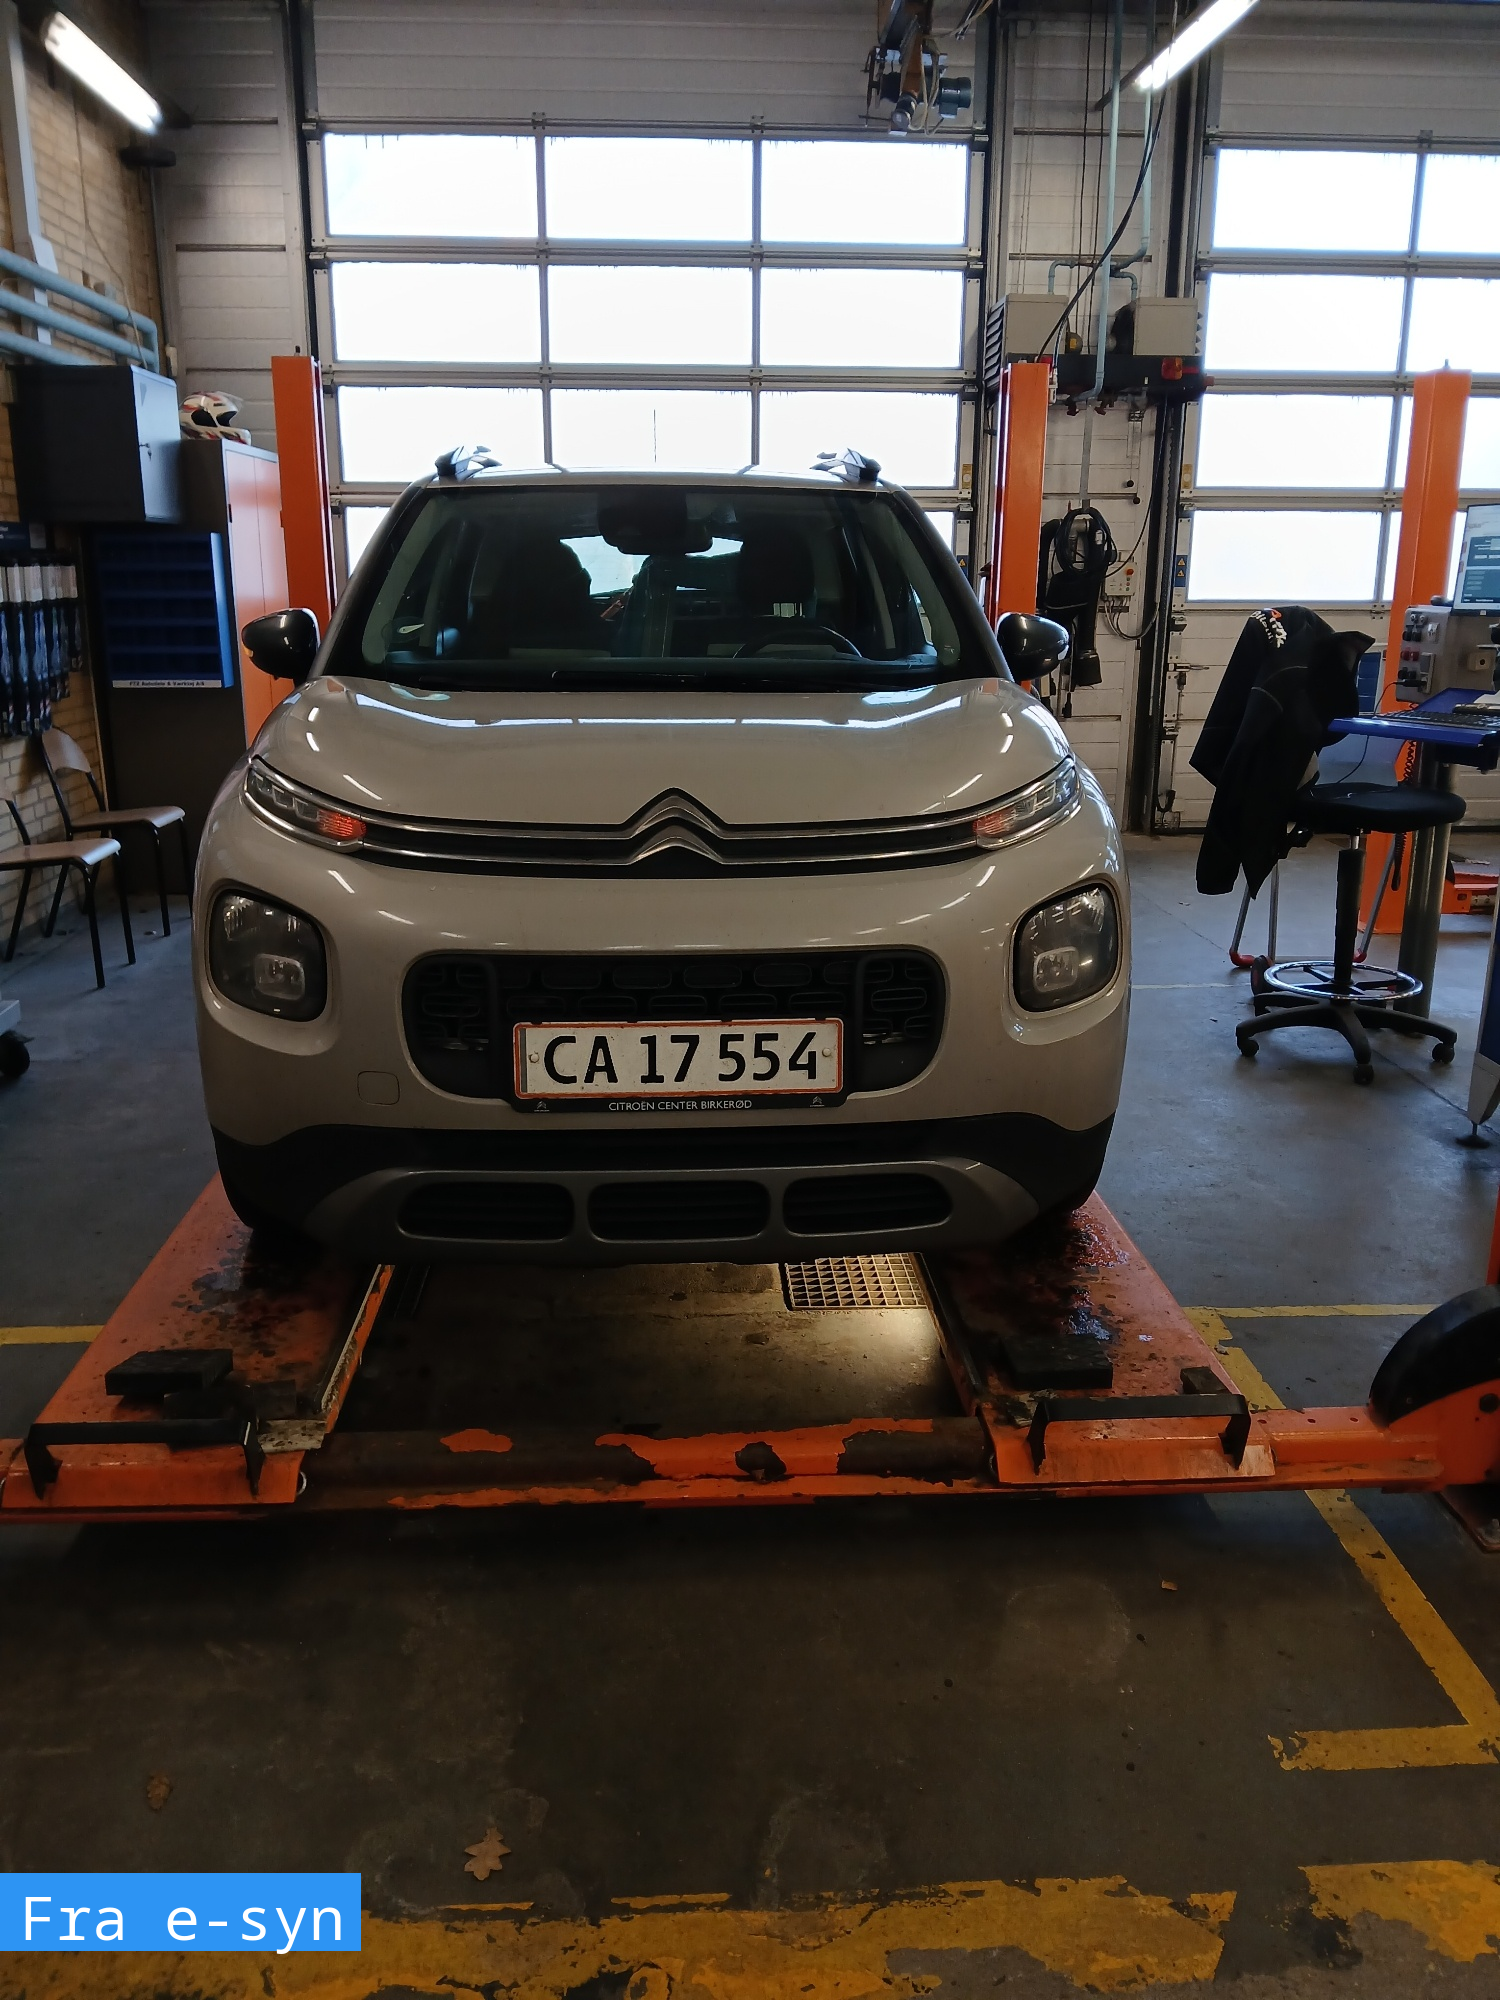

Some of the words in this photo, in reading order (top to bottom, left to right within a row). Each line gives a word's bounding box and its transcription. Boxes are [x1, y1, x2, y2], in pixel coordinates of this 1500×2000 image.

[543, 1035, 618, 1085] CA
[640, 1034, 700, 1084] 17
[718, 1031, 818, 1082] 554
[608, 1100, 655, 1111] CITROËN
[657, 1101, 698, 1110] CENTER
[701, 1099, 753, 1110] BIRKERØD
